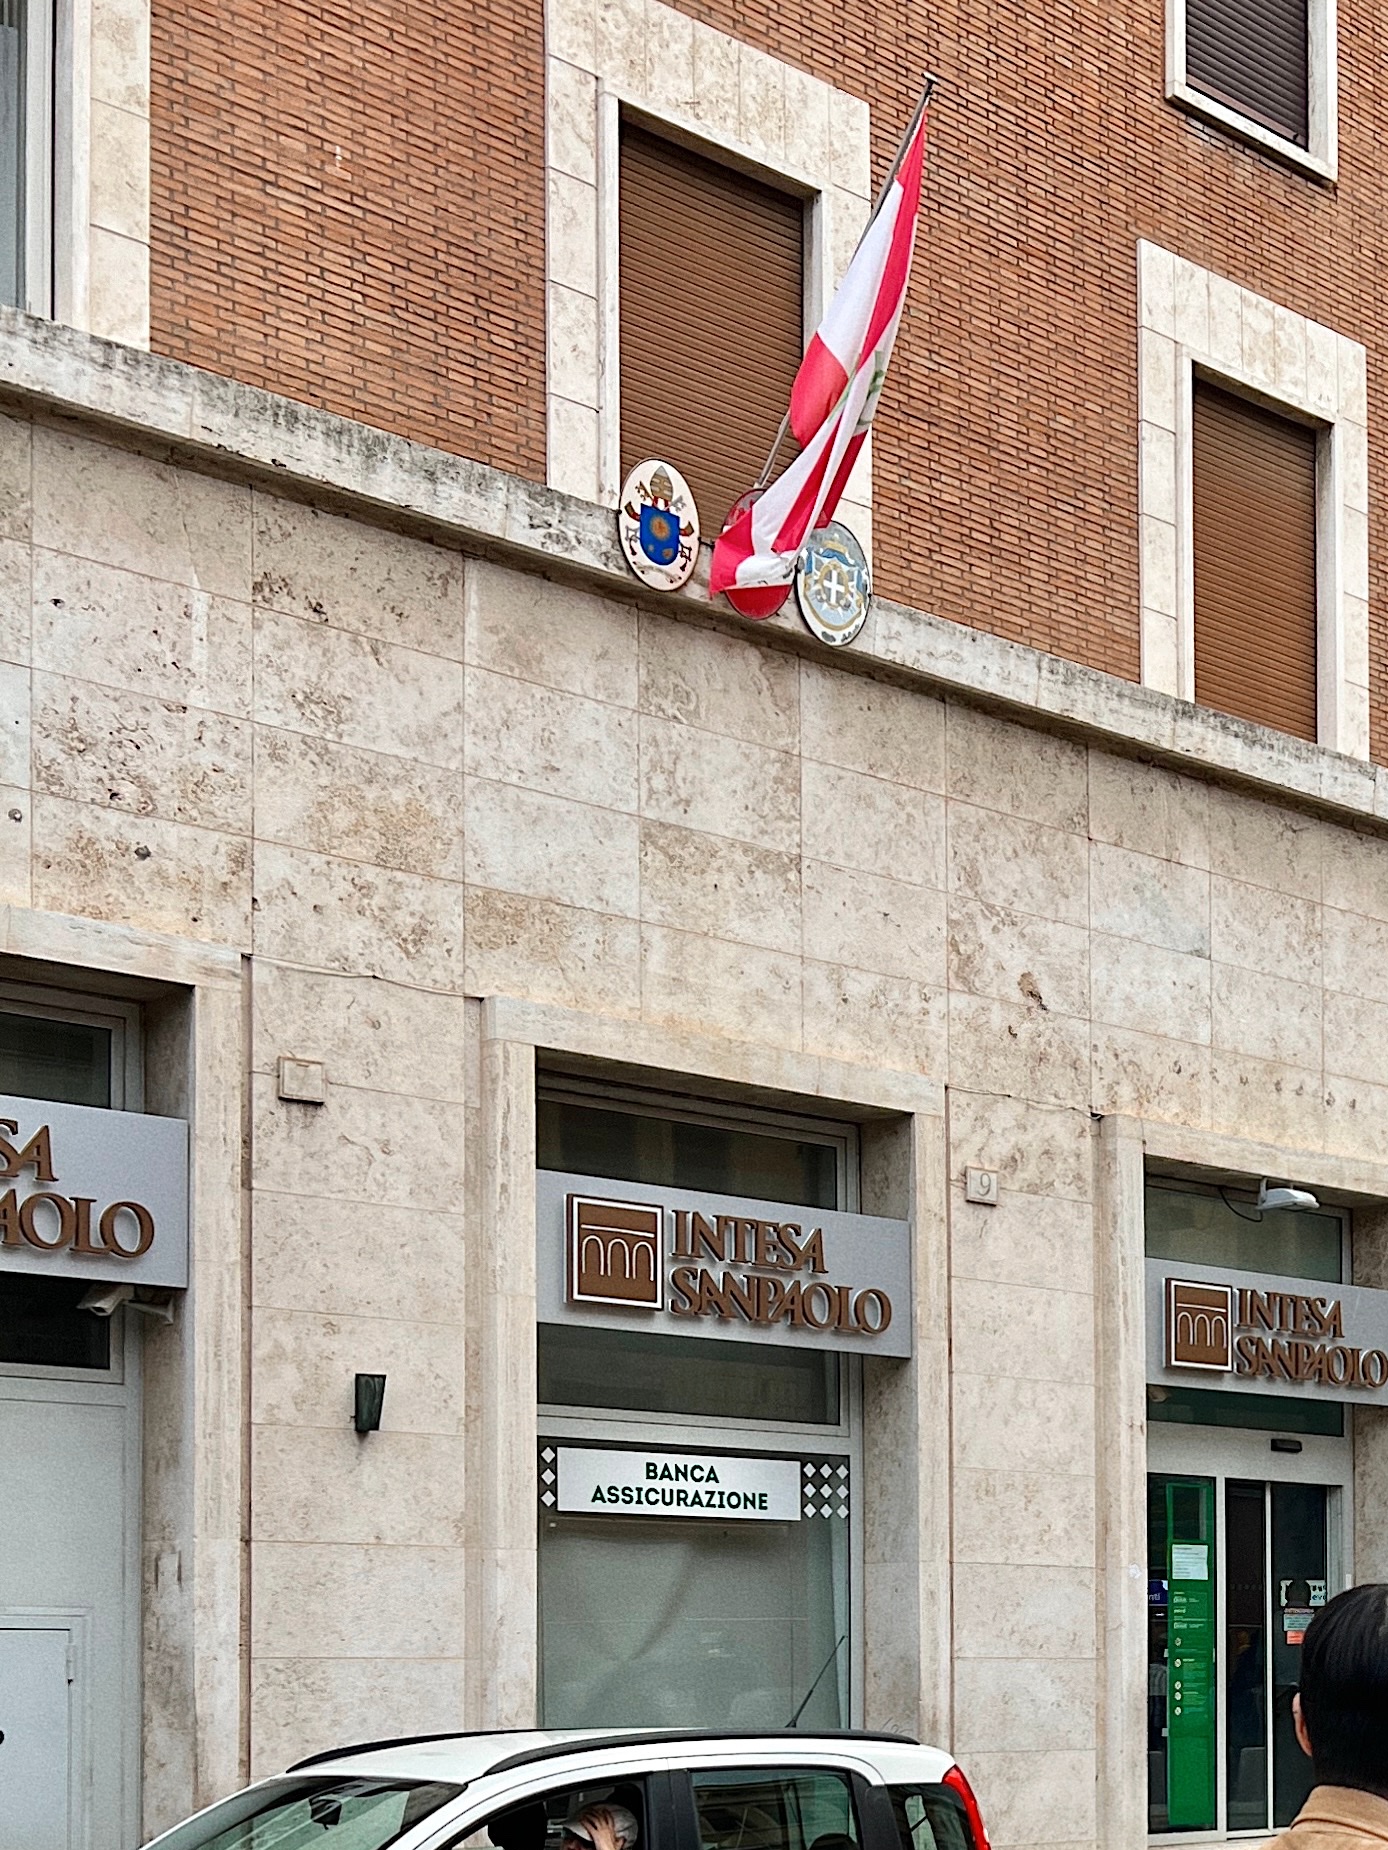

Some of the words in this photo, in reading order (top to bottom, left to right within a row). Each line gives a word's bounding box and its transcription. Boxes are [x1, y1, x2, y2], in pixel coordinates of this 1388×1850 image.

[669, 1209, 829, 1274] INTESA
[670, 1267, 892, 1334] SANPAOLO
[1234, 1287, 1344, 1339] INTESA
[591, 1484, 768, 1511] ASSICURAZIONE
[645, 1461, 720, 1485] BANCA
